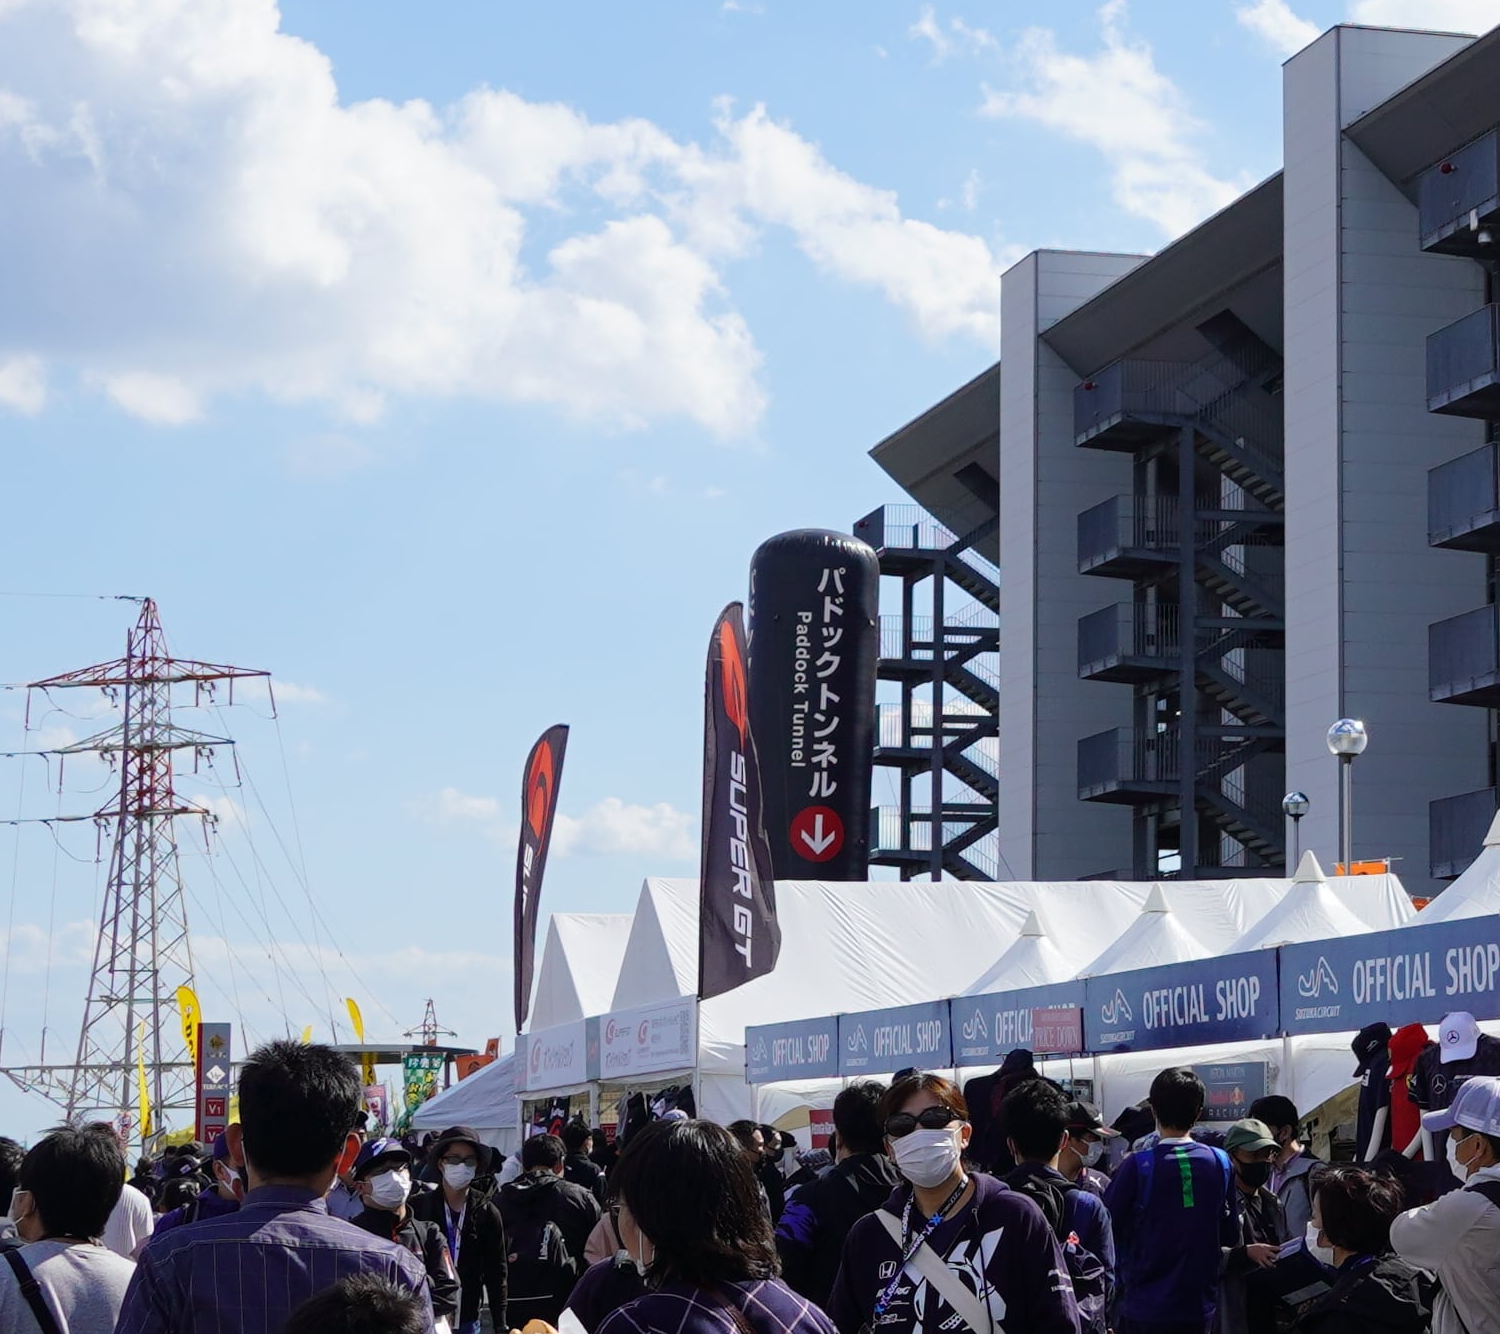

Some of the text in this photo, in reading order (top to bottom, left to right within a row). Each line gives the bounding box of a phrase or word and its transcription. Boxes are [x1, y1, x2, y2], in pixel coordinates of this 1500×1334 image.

[790, 611, 813, 767] Paddock Tunnel
[808, 567, 846, 798] パドックトンネル
[728, 751, 753, 968] SUPER GT
[1352, 943, 1500, 1005] OFFICIAL SHOP
[995, 1007, 1033, 1045] OFFICIA
[1142, 975, 1261, 1030] OFFICIAL SHOP
[772, 1034, 830, 1066] OFFICIAL SHOP
[873, 1020, 942, 1057] OFFICIAL SHOP
[1035, 1026, 1054, 1047] PRICE
[1057, 1026, 1079, 1047] DOWN
